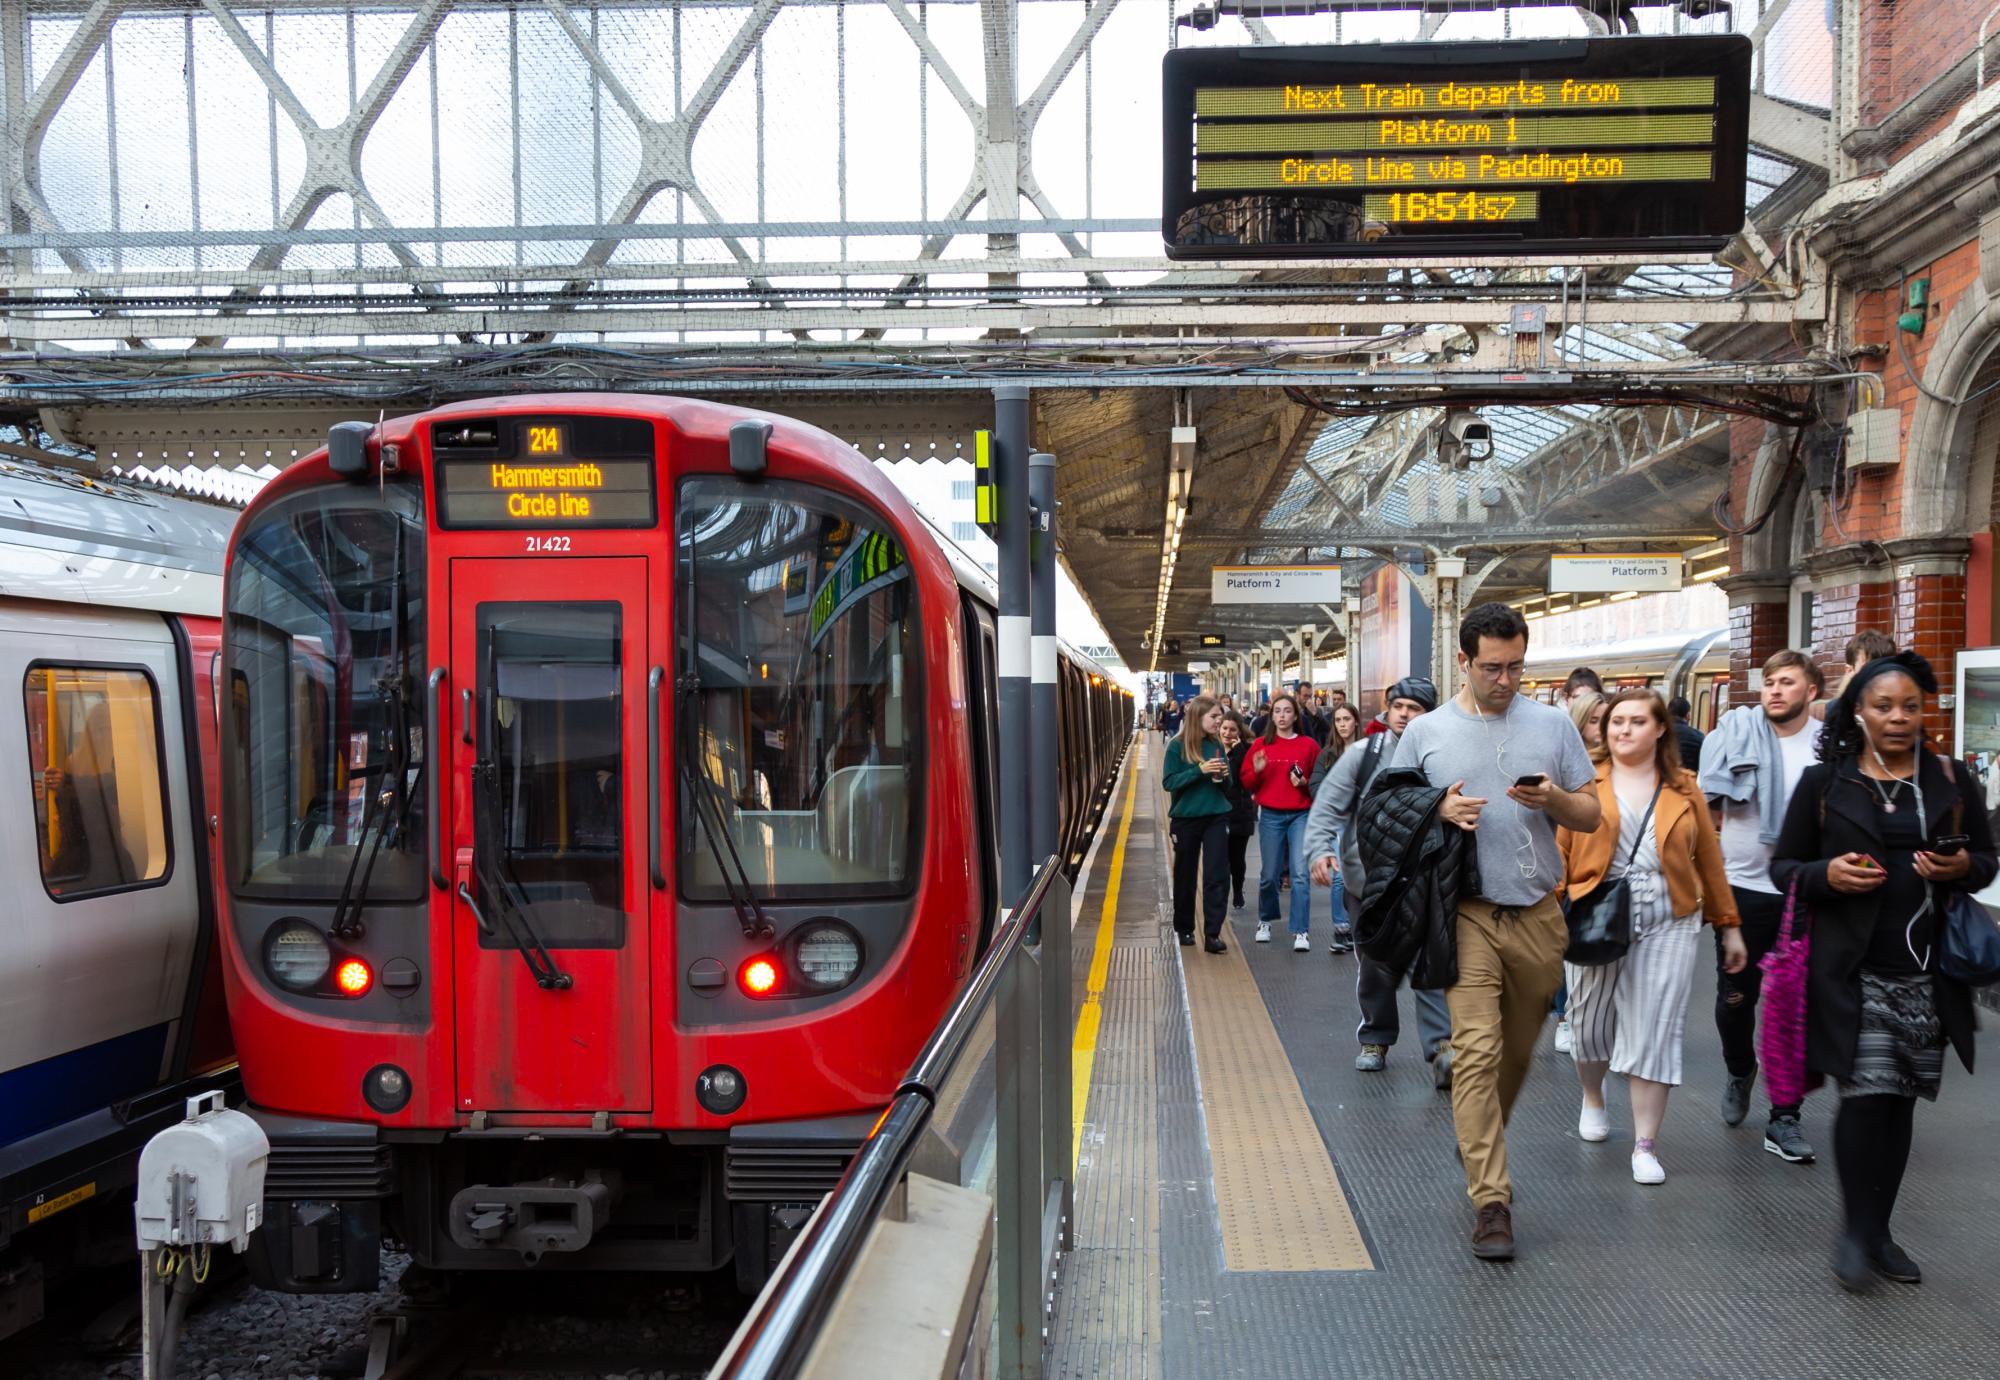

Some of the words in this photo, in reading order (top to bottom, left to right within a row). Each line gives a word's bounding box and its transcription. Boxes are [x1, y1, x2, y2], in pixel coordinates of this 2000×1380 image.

[1284, 84, 1345, 109] Next
[1360, 83, 1425, 108] Train
[1438, 80, 1546, 110] departs
[1560, 79, 1620, 102] from
[1380, 118, 1491, 144] Platform
[1507, 117, 1518, 142] 1
[1281, 157, 1354, 183] Circle
[1367, 157, 1415, 181] Line
[1428, 155, 1465, 179] via
[1479, 153, 1623, 183] Paddington
[1388, 192, 1517, 221] 16:54:57
[530, 428, 558, 451] 214
[492, 463, 602, 488] Hammersmith
[509, 493, 556, 517] Circle
[560, 493, 590, 516] line
[526, 536, 571, 551] 21422
[1612, 566, 1658, 576] Platform
[1661, 566, 1668, 576] 3
[1227, 579, 1272, 588] Platform
[1275, 579, 1281, 588] 2
